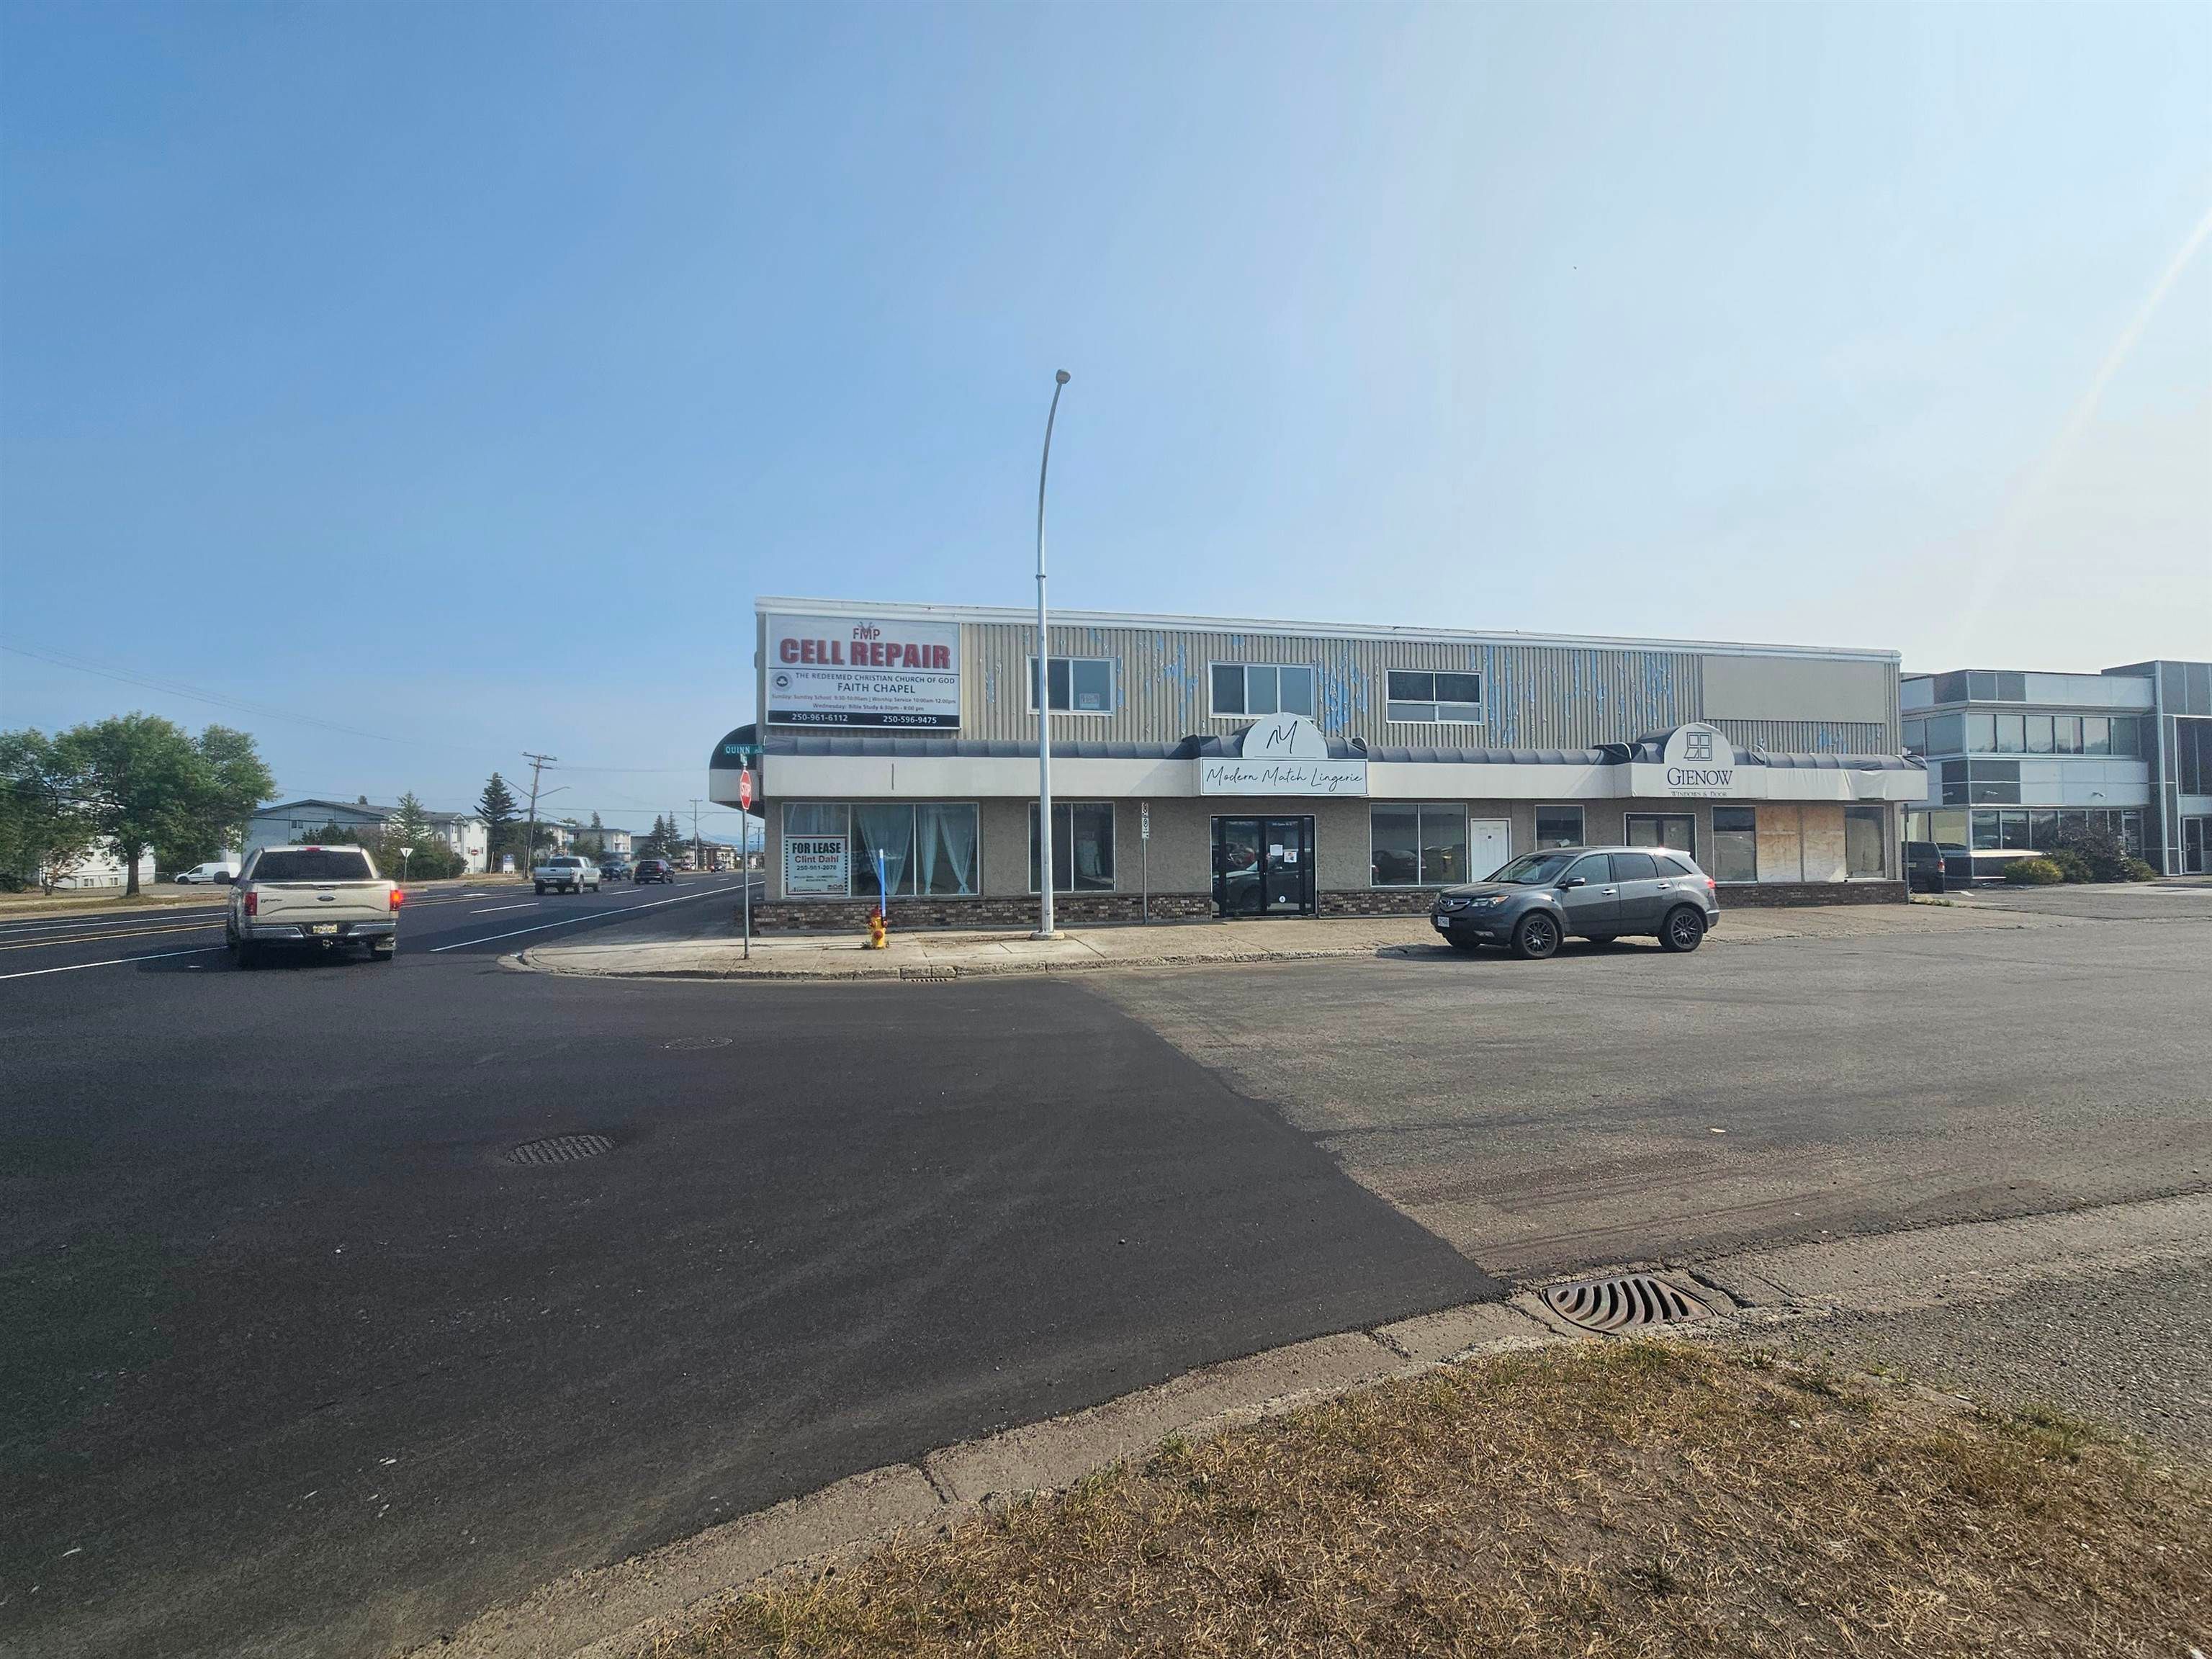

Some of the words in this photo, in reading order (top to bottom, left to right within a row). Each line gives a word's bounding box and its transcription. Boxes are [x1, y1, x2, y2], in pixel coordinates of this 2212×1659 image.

[853, 627, 881, 640] FMP
[779, 638, 846, 665] CELL
[850, 642, 950, 669] REPAIR
[837, 683, 870, 692] FAITH
[873, 683, 916, 693] CHAPEL
[1206, 765, 1259, 786] Modern
[1262, 766, 1308, 786] Match
[1310, 767, 1363, 792] Lingerie
[1667, 768, 1733, 786] GIENOW
[792, 842, 811, 854] FOR
[813, 842, 841, 854] LEASE
